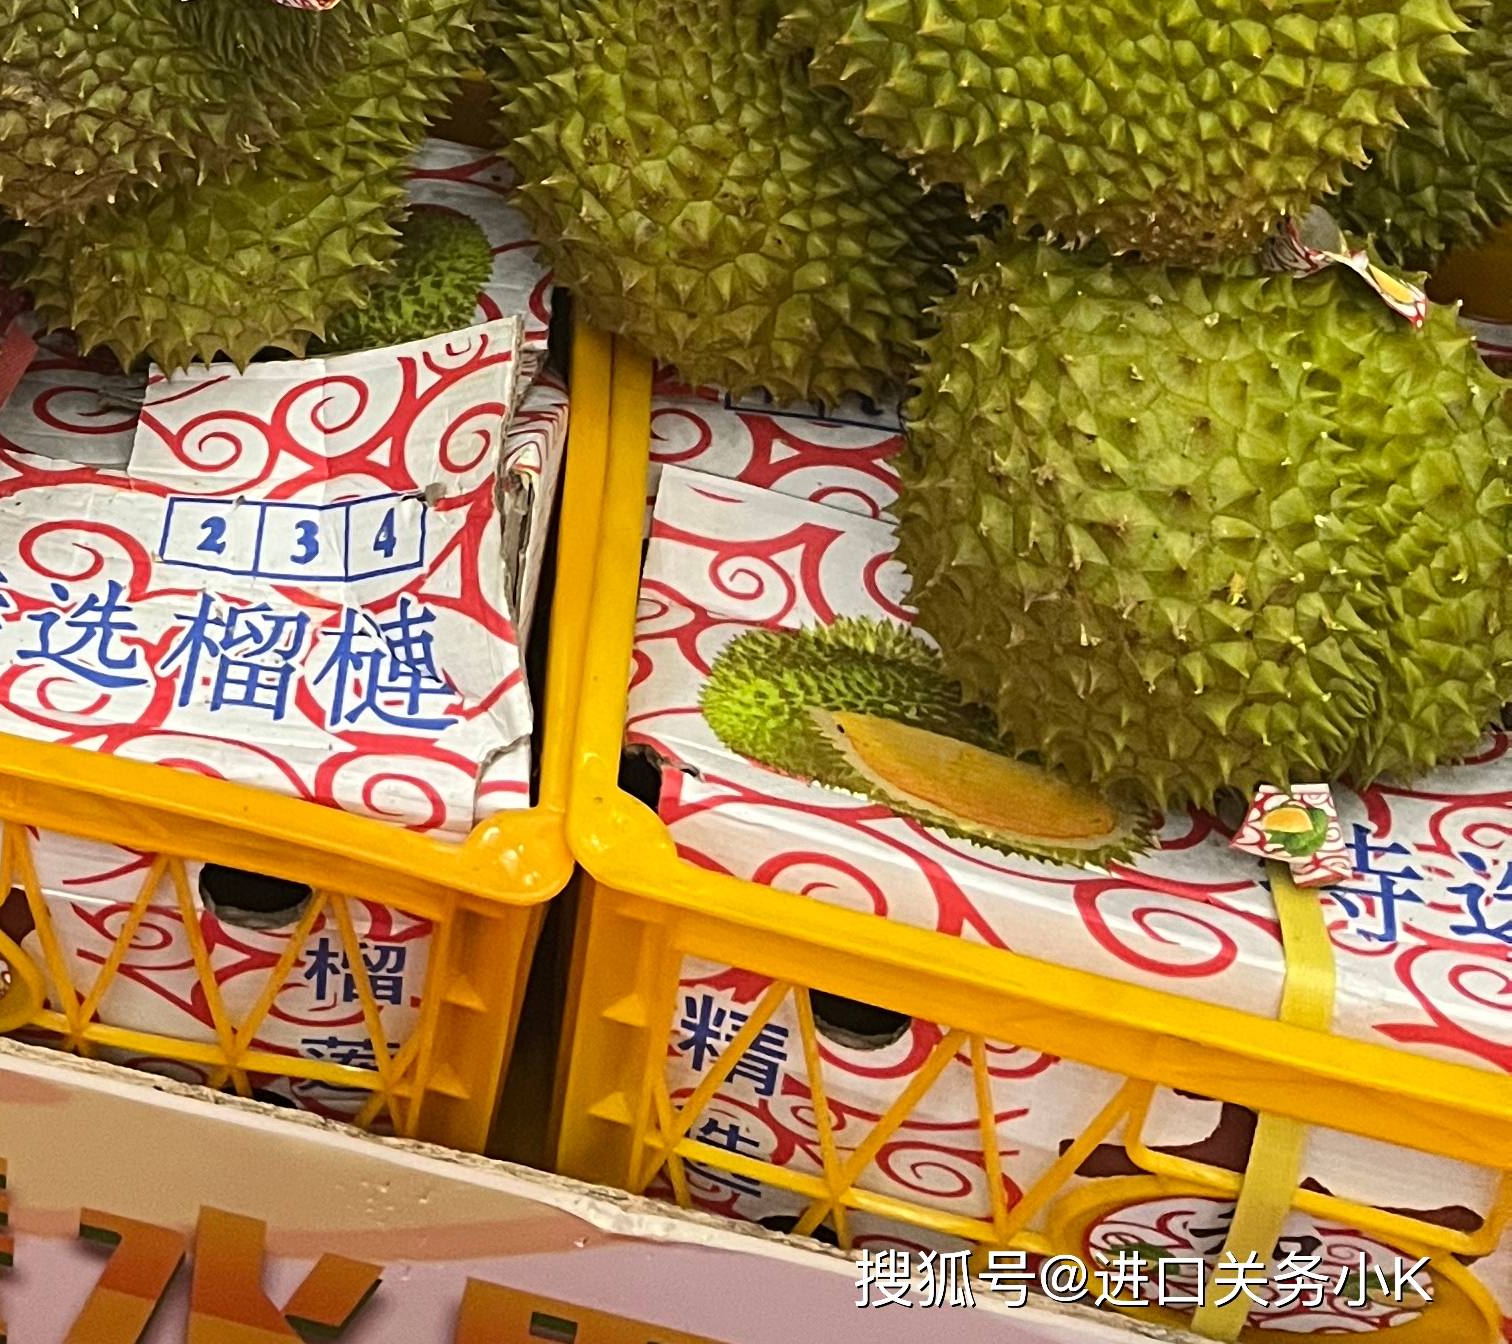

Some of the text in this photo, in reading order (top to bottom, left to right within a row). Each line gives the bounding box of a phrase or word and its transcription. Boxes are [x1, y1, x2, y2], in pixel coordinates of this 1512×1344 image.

[196, 507, 397, 565] 2 3 4
